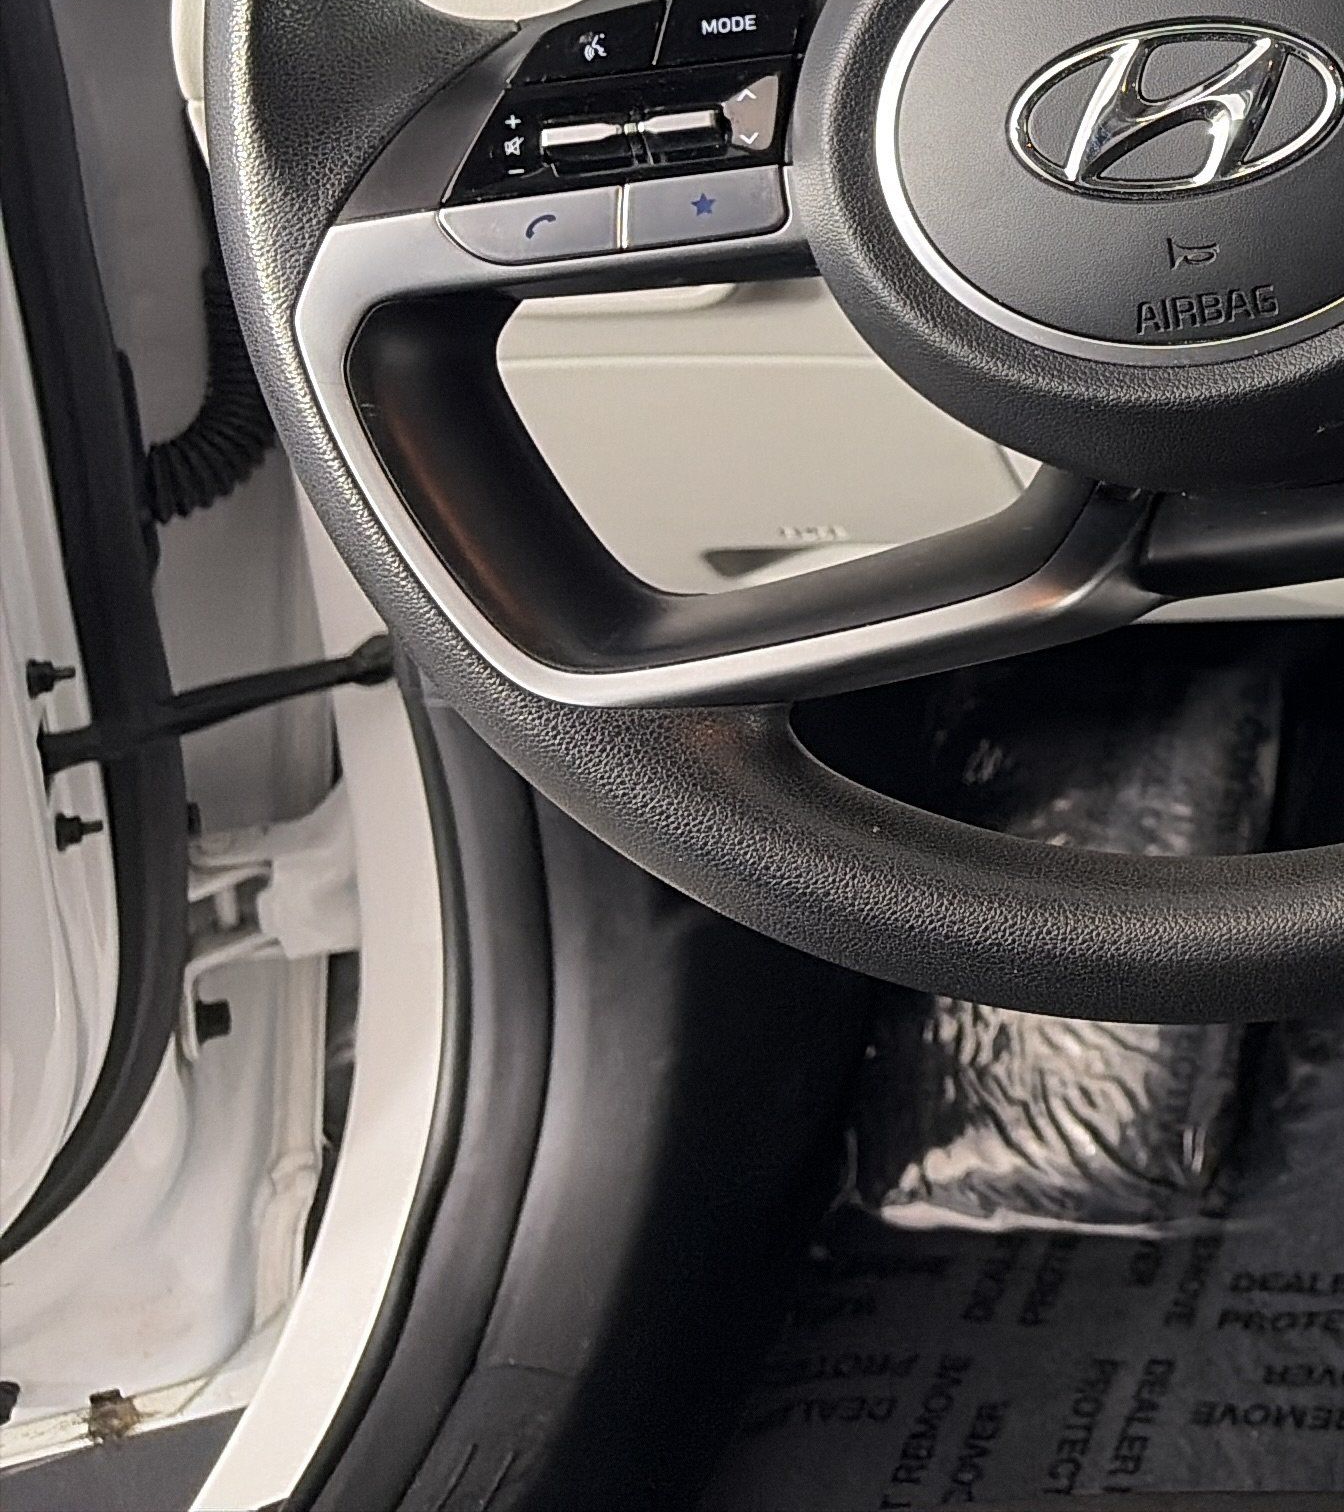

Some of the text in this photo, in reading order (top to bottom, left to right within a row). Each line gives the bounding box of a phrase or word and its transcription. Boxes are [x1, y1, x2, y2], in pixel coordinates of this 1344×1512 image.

[701, 15, 757, 35] MODE
[1134, 284, 1280, 335] AIRBAG
[889, 1354, 973, 1485] REMOVE
[1107, 1357, 1177, 1478] DEALER
